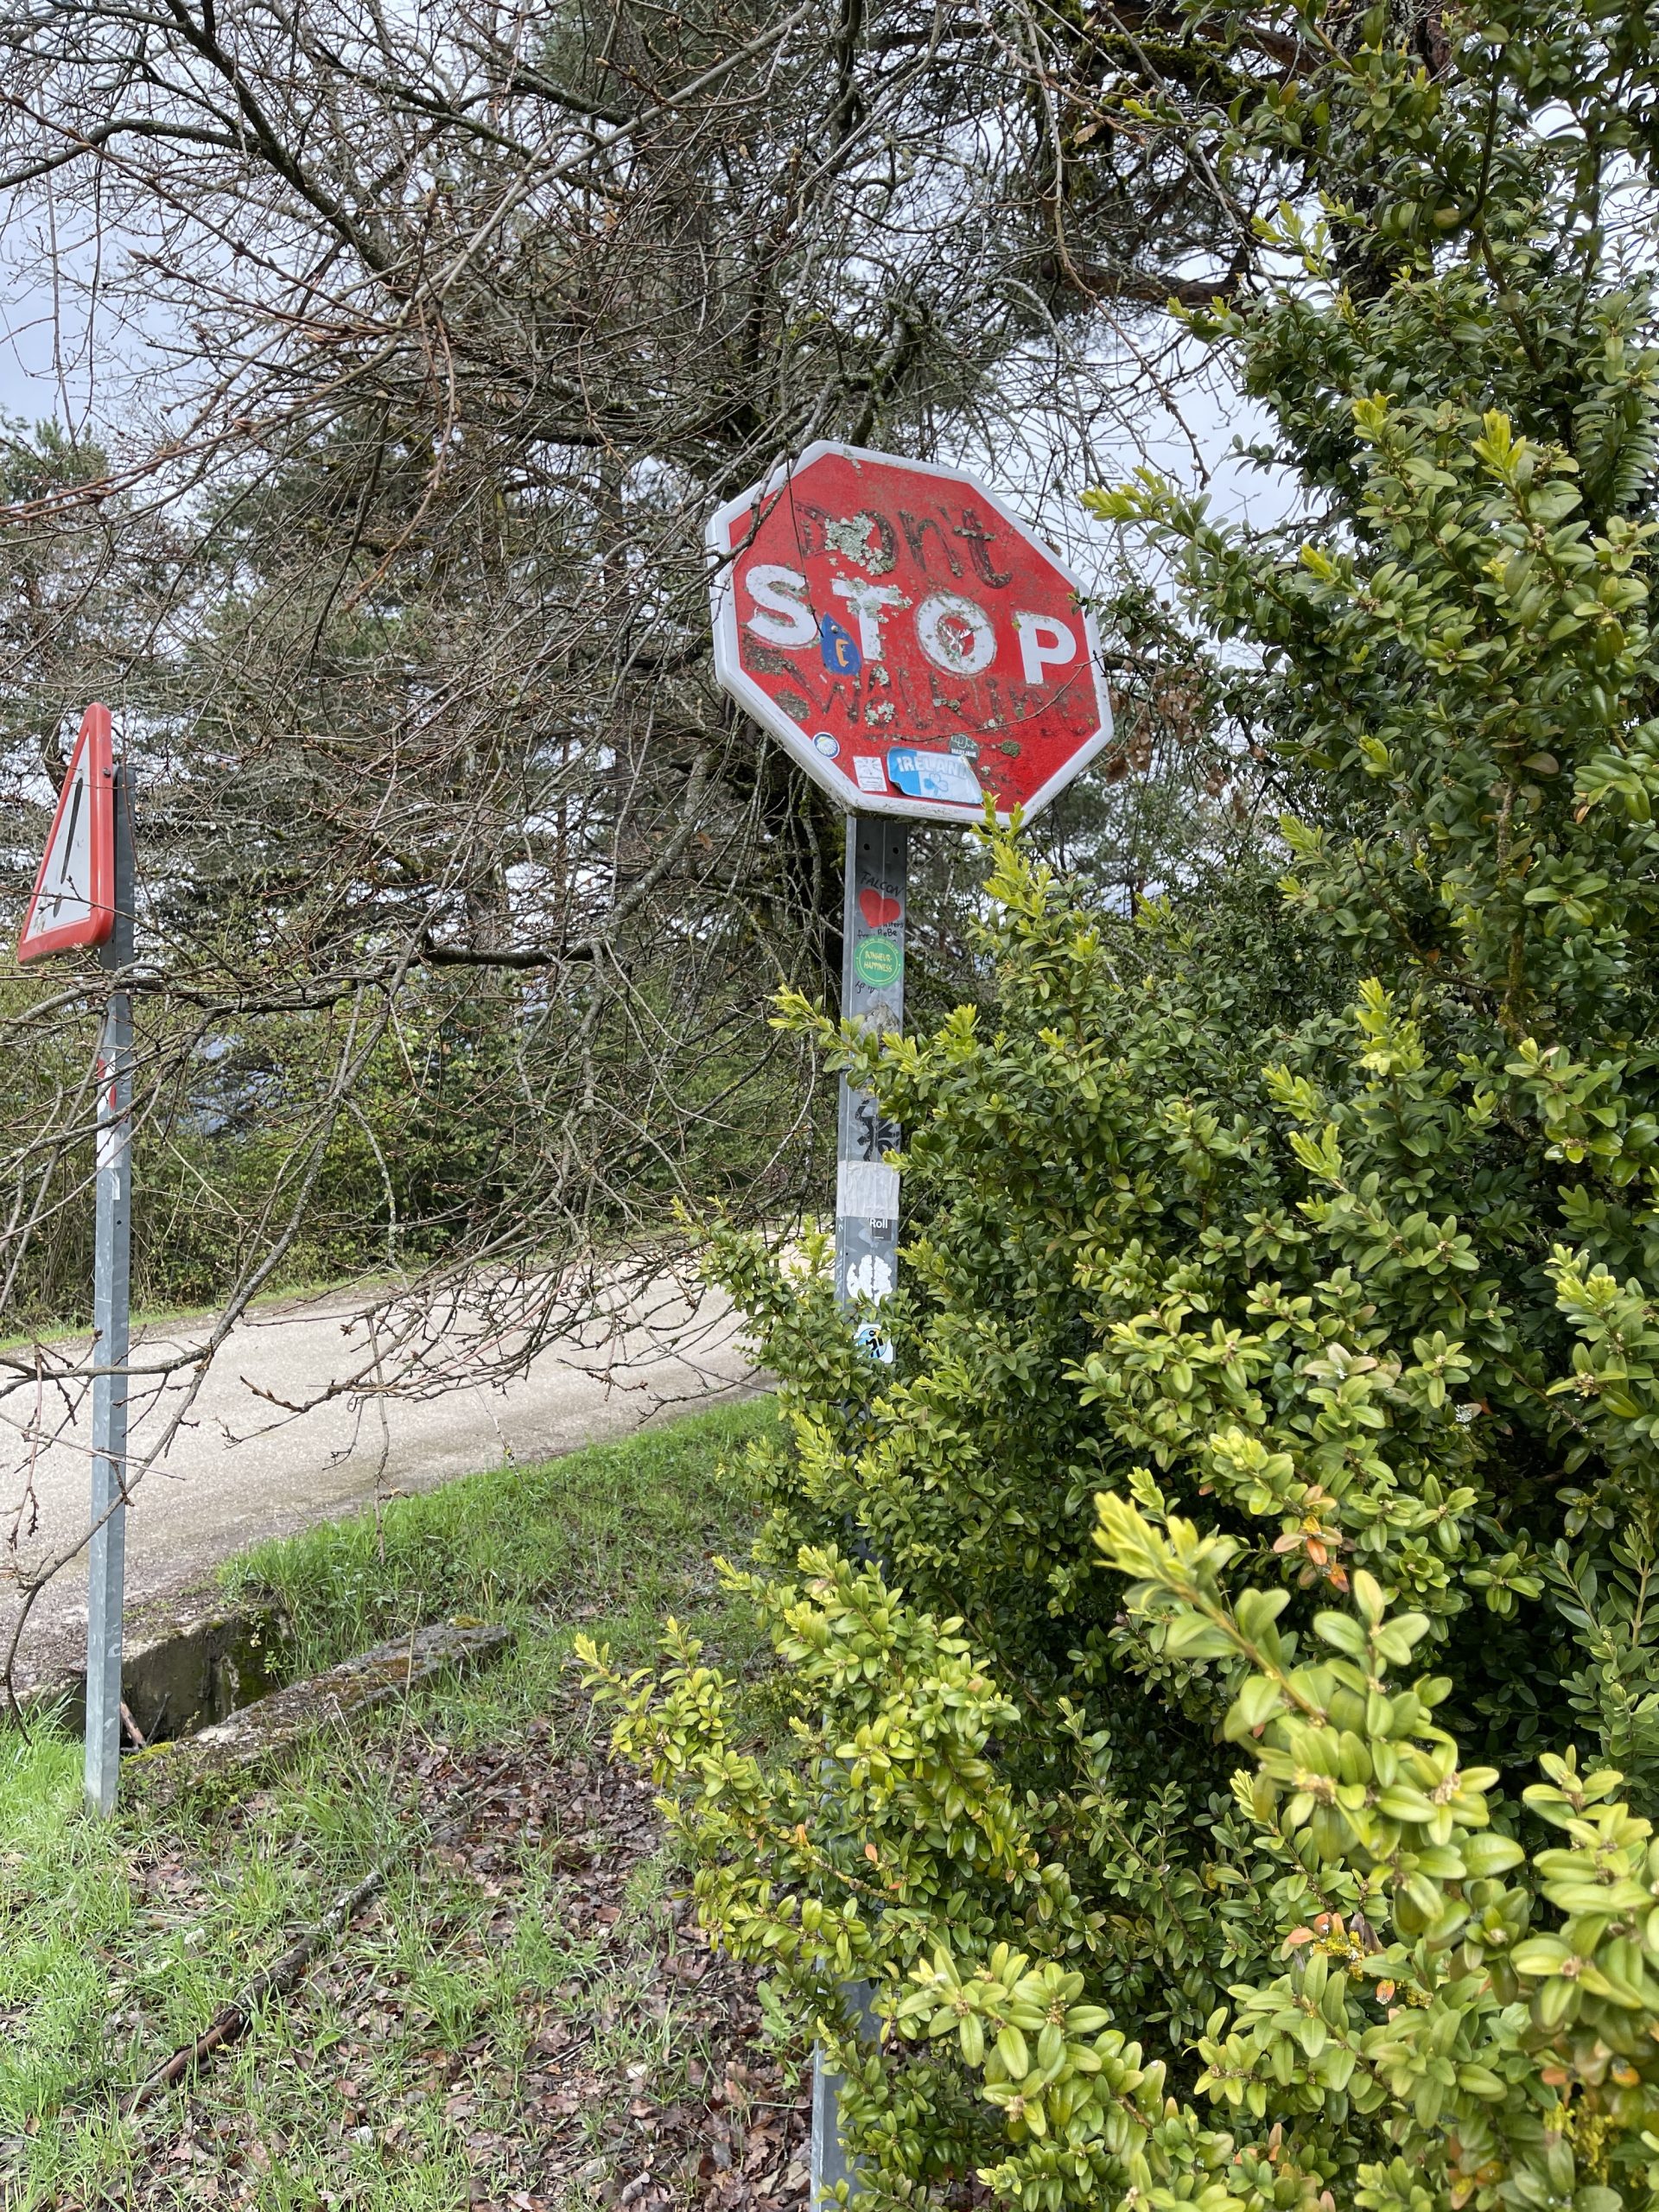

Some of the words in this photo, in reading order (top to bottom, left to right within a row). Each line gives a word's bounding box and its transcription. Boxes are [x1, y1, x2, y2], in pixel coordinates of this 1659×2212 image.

[746, 564, 1077, 685] STOP
[896, 754, 968, 779] IRELAND
[859, 871, 905, 898] FALCON
[863, 961, 893, 973] HAPPINESS
[869, 1218, 888, 1229] Roll
